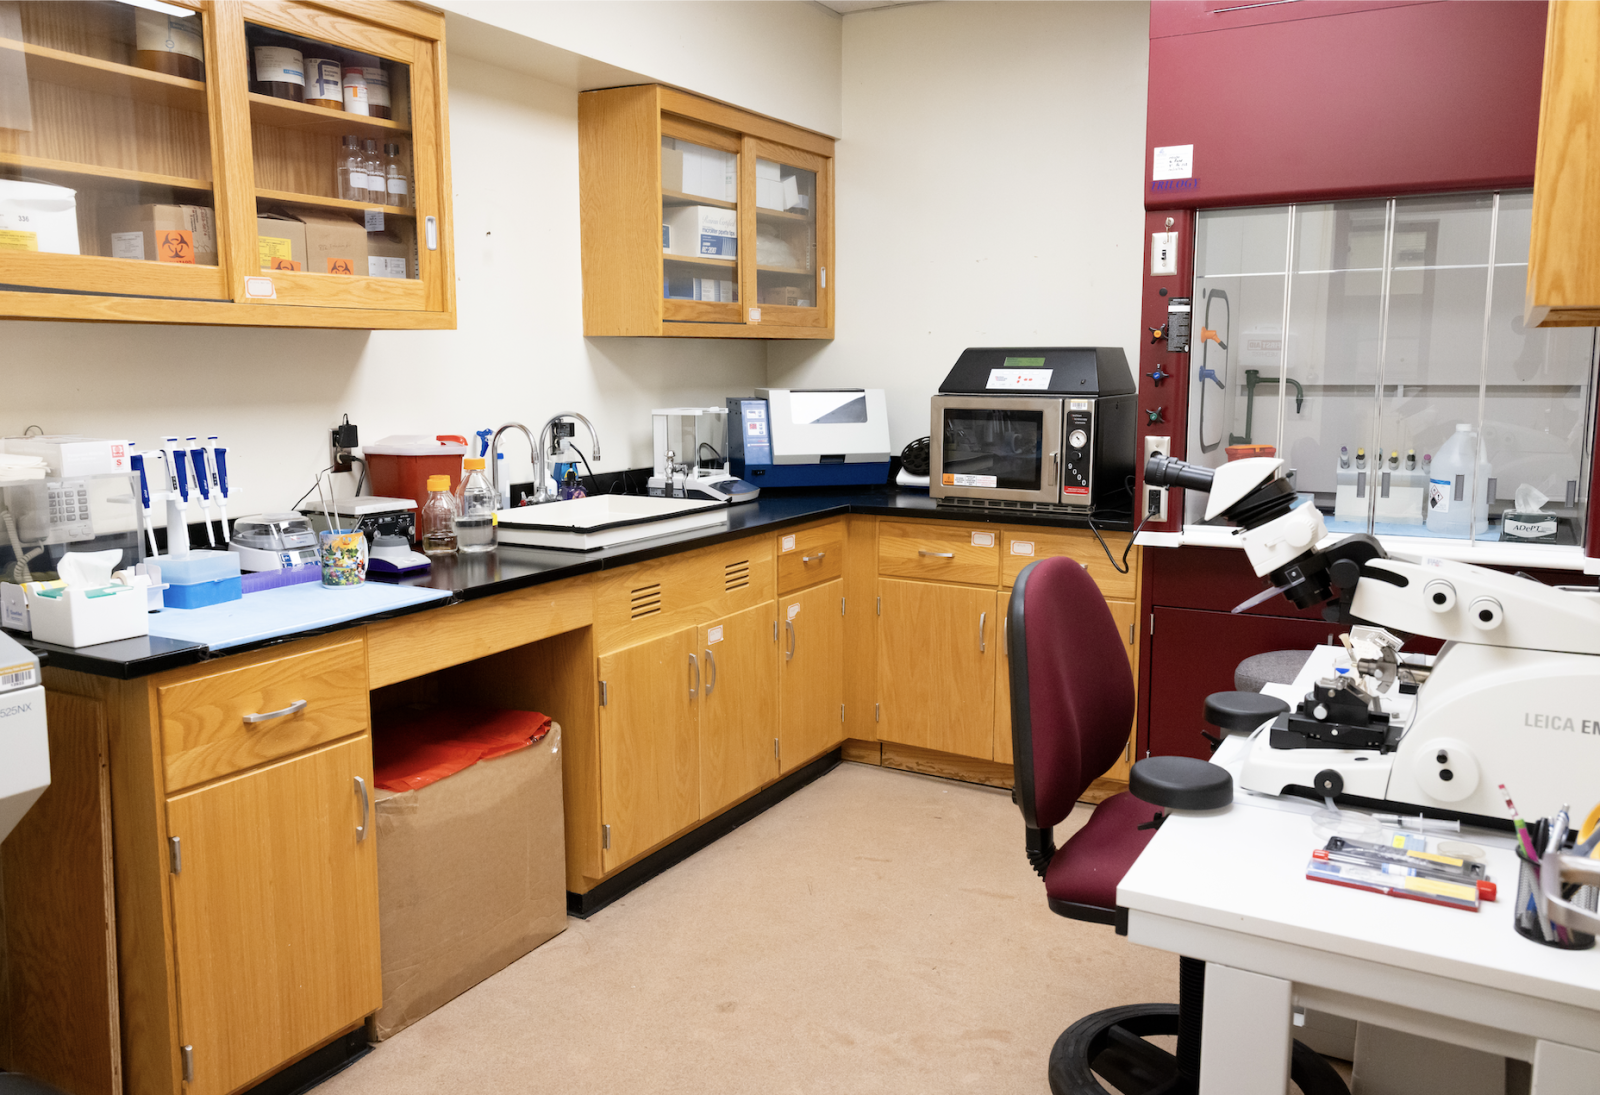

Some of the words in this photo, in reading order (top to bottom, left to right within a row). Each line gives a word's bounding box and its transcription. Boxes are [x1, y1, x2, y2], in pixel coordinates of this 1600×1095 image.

[1151, 178, 1201, 191] TRILOGY
[18, 215, 30, 223] 336
[1523, 711, 1576, 733] LEICA
